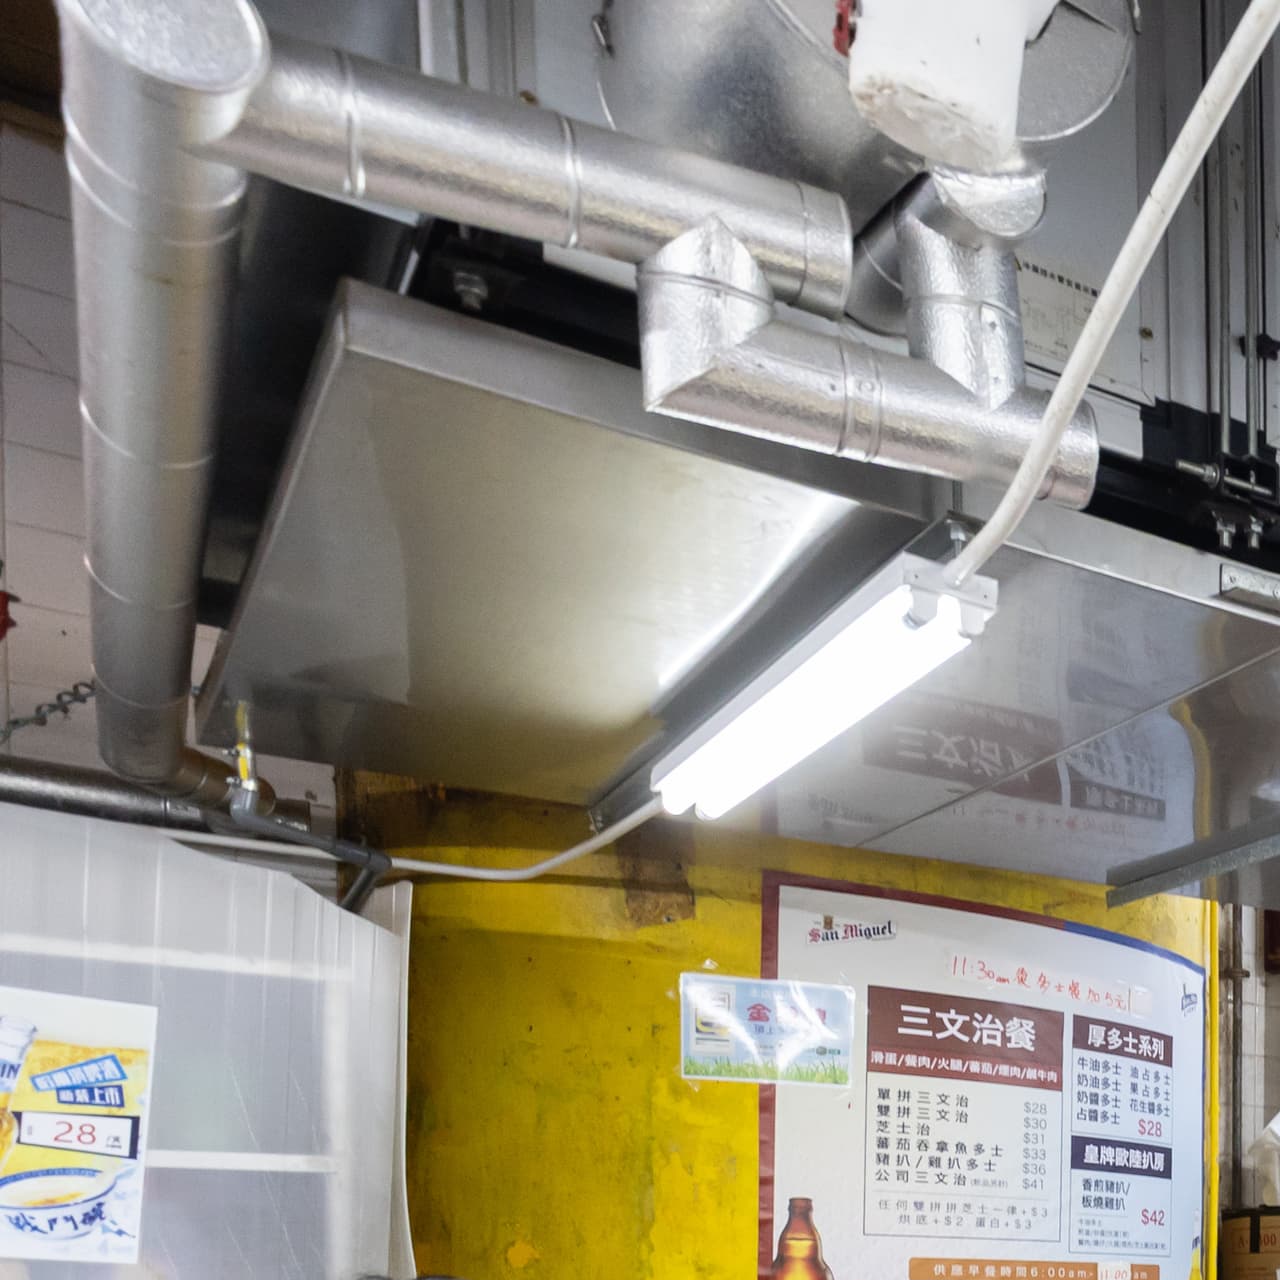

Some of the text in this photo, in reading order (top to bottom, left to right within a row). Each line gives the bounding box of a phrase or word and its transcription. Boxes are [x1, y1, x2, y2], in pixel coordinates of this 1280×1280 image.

[808, 920, 893, 943] San Miguel
[898, 1004, 1035, 1051] 三文治餐
[1088, 1024, 1164, 1060] 厚多士系列
[1077, 1057, 1122, 1075] 牛油多士
[1077, 1074, 1122, 1092] 奶油多士
[877, 1088, 1047, 1115] 單拼三文治 $28
[1077, 1091, 1121, 1109] 奶醬多士
[877, 1104, 1047, 1130] 雙拼三文治 $30
[1138, 1119, 1162, 1137] $28
[876, 1120, 1045, 1145] 芝士治 $31
[876, 1136, 1046, 1160] 蕃茄吞拿魚多士 $33
[1083, 1144, 1165, 1171] 皇牌歐陸扒房
[875, 1169, 1044, 1190] 公司三文治 $41
[1022, 1162, 1046, 1175] $36
[1082, 1195, 1126, 1211] 板燒雞扒
[1141, 1208, 1165, 1226] $42
